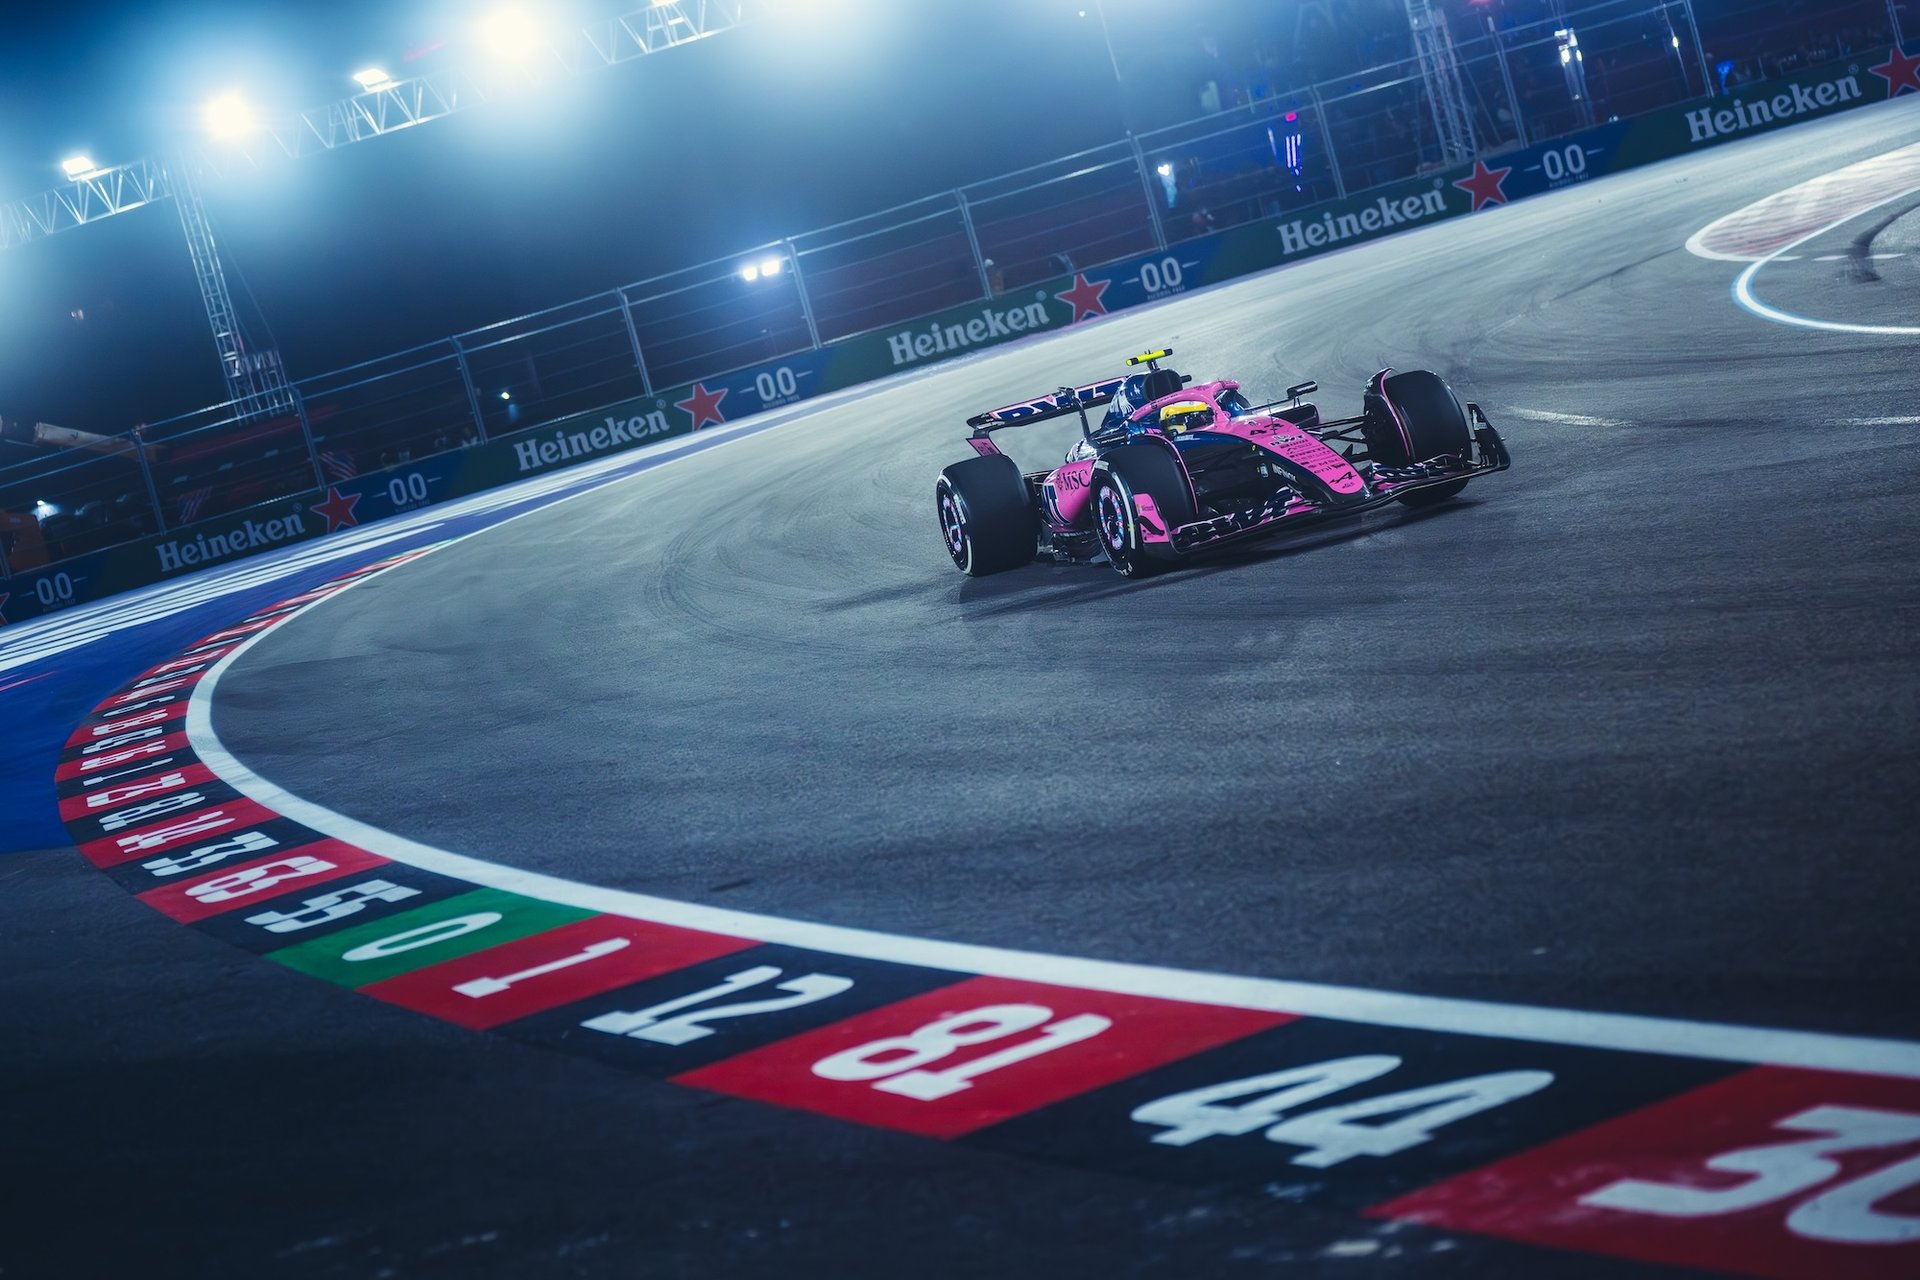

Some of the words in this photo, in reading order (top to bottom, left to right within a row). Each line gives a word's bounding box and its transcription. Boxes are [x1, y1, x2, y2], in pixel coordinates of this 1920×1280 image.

[1684, 75, 1863, 143] Heineken
[1542, 143, 1586, 181] 0.0
[1276, 188, 1448, 255] Heineken
[1140, 256, 1184, 292] 0.0
[886, 301, 1051, 366] Heineken
[755, 366, 797, 401] 0.0
[514, 408, 670, 471] Heineken
[388, 472, 427, 506] 0.0
[1061, 469, 1091, 491] MSC
[154, 512, 306, 572] Heineken
[36, 572, 73, 605] 0.0
[82, 726, 162, 755] 43
[92, 709, 168, 736] 18
[80, 740, 166, 770] 16
[83, 757, 173, 786] 1
[86, 772, 186, 808] 23
[98, 792, 206, 831] 81
[116, 810, 236, 853] 14
[141, 831, 280, 876] 33
[185, 856, 339, 903] 63
[244, 879, 423, 933] 55
[341, 911, 503, 962] 0
[451, 937, 631, 999] 1
[580, 965, 854, 1046] 12
[811, 1004, 1113, 1102] 81
[1130, 1053, 1556, 1170] 44
